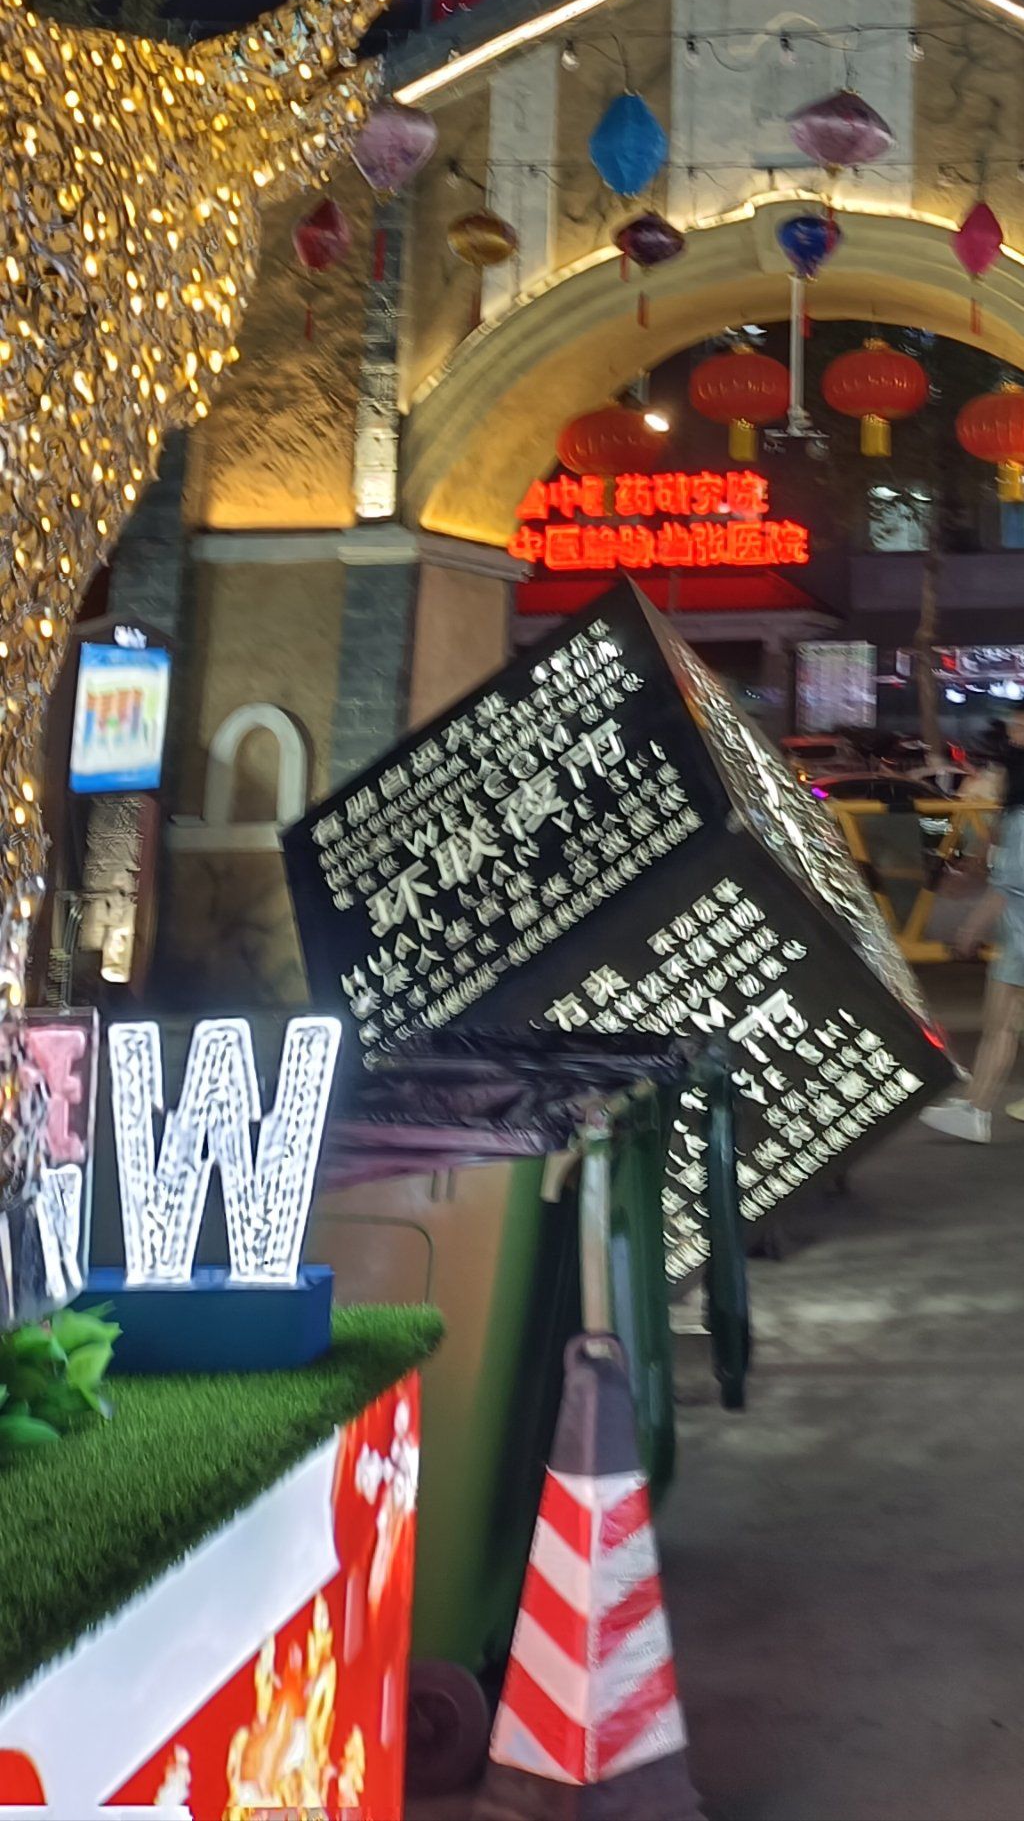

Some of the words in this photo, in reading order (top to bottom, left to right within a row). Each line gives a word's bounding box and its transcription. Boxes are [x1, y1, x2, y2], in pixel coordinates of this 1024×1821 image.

[365, 719, 625, 936] 环联夜市
[344, 910, 443, 997] HUAN
[531, 965, 630, 1031] 方来
